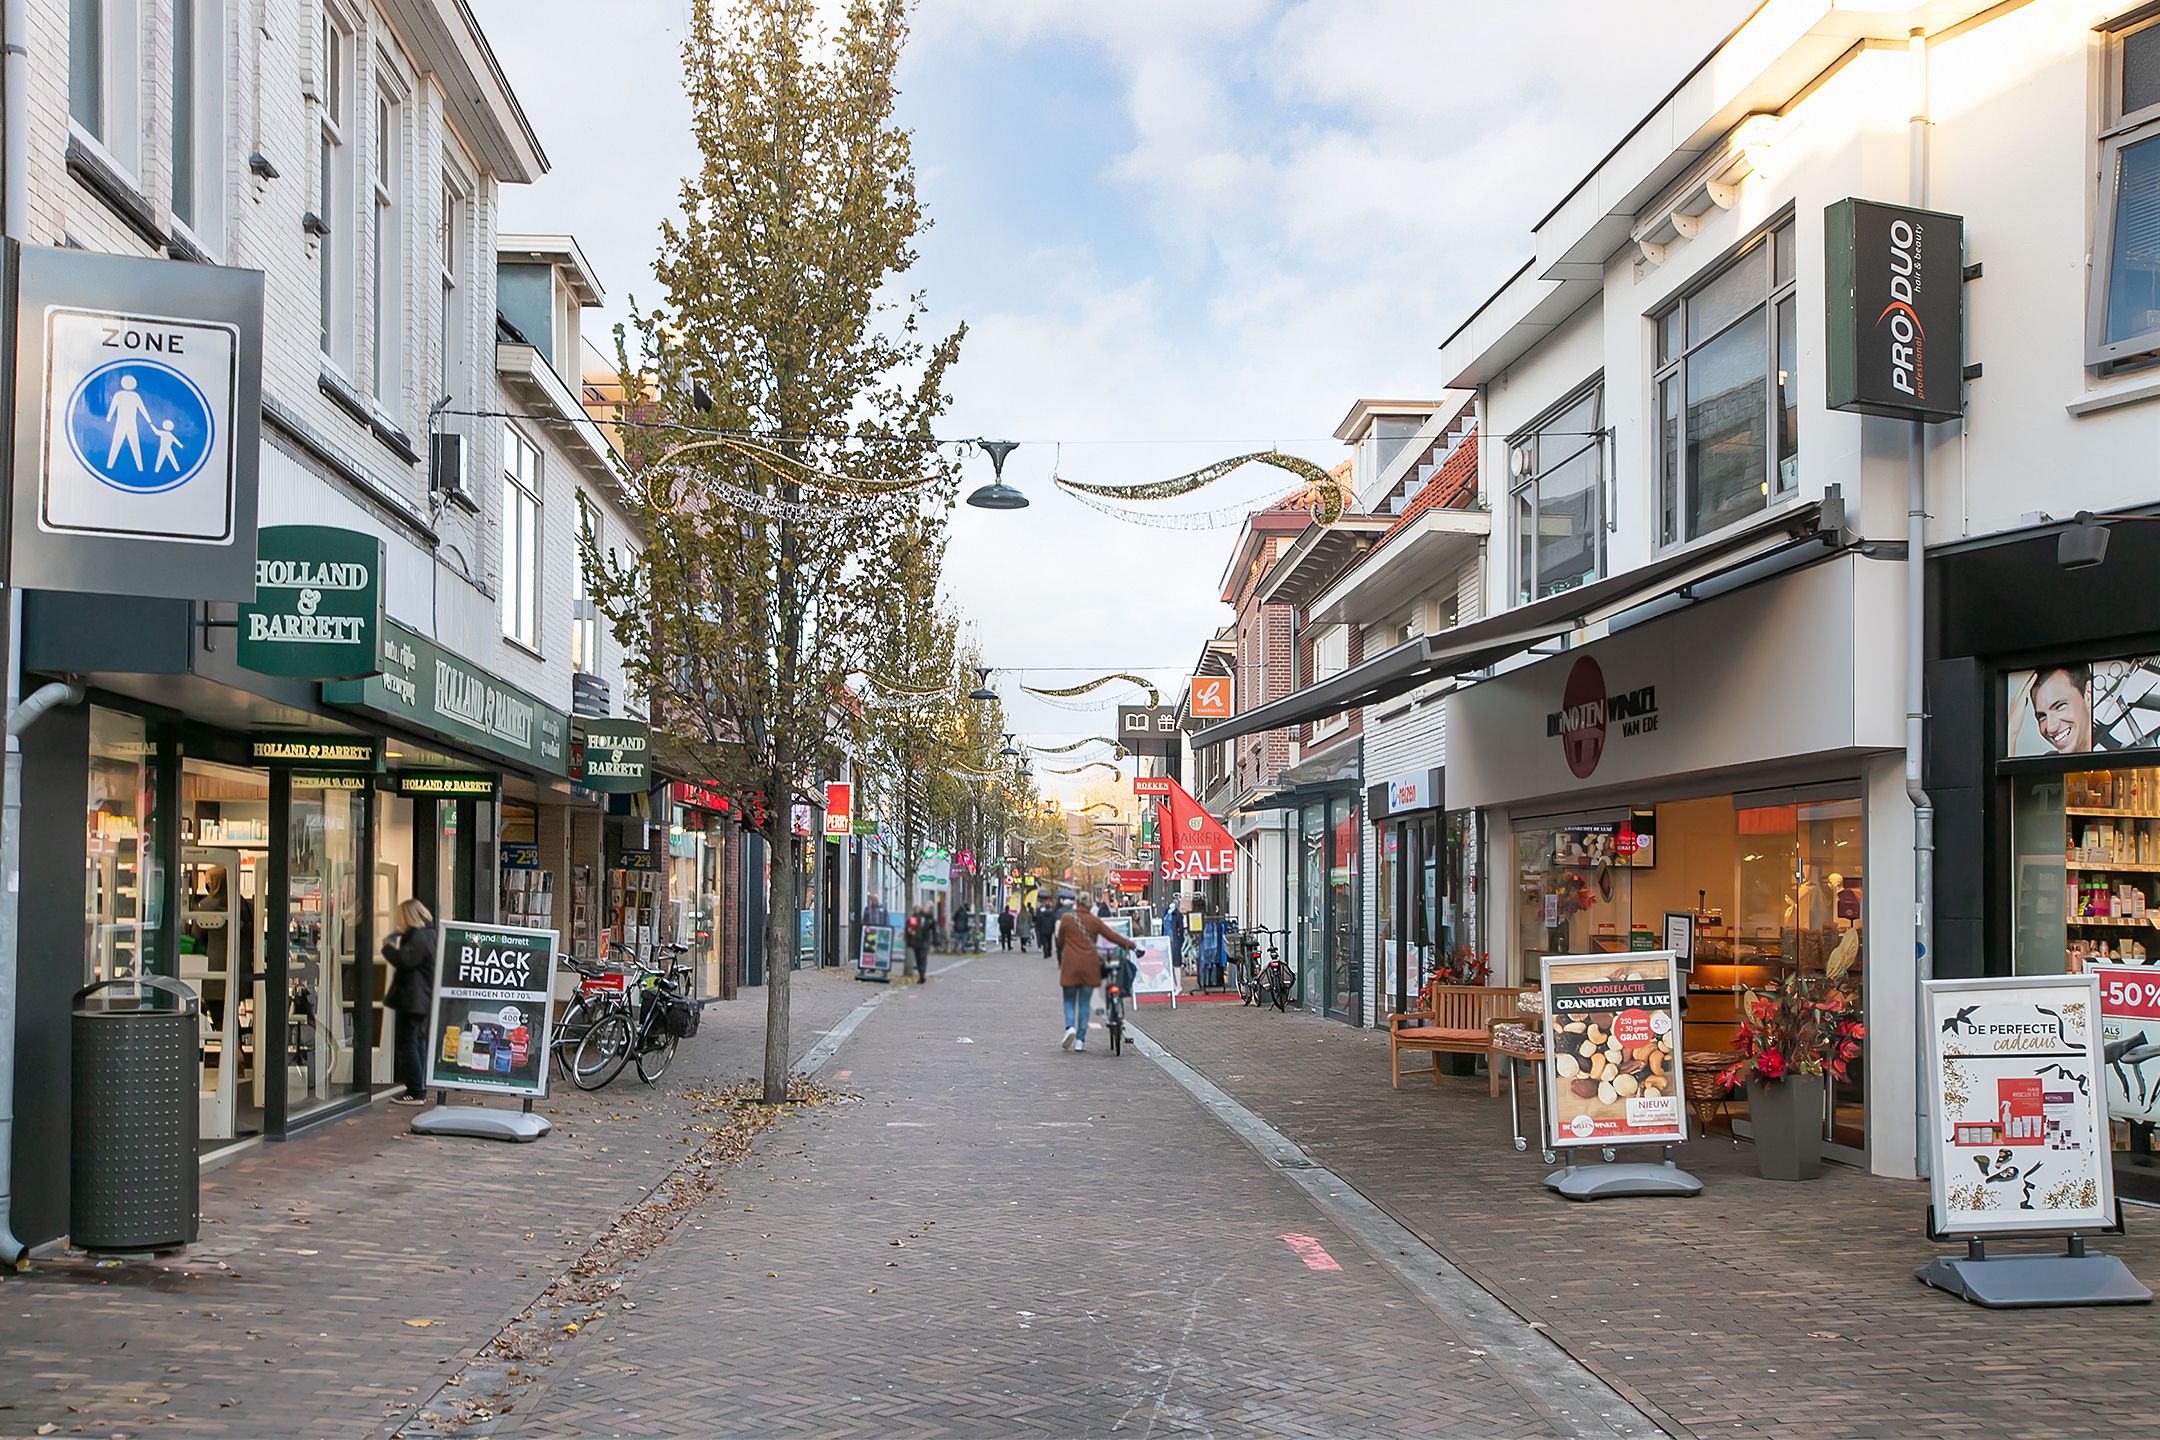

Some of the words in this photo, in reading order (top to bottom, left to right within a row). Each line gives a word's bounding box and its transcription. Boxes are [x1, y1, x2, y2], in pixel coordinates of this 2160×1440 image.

[1914, 223, 1924, 260] beauty
[102, 328, 184, 354] ZONE
[1916, 336, 1925, 400] professional
[256, 560, 369, 591] HOLLAND
[297, 588, 322, 616] &
[248, 613, 365, 644] BARRETT
[434, 658, 486, 733] HOLLAND
[485, 686, 496, 735] &
[492, 690, 534, 750] BARRETT
[1622, 720, 1640, 738] VAN
[1642, 715, 1658, 733] EDE
[588, 735, 646, 751] HOLLAND
[253, 743, 308, 758] HOLLAND
[308, 745, 320, 759] &
[319, 746, 372, 761] BARRETT
[611, 749, 623, 763] &
[588, 762, 644, 777] BARRETT
[402, 778, 444, 792] HOLLAND
[444, 781, 453, 792] &
[453, 781, 492, 793] BARRETT
[1136, 781, 1169, 791] BOEKEN
[828, 815, 848, 829] PERRY
[1173, 832, 1222, 844] BAKKER
[501, 851, 509, 863] 4
[1174, 850, 1233, 873] SALE
[501, 935, 530, 946] Barrett
[461, 946, 531, 971] BLACK
[458, 966, 530, 988] FRIDAY
[451, 989, 499, 999] KORTINGEN
[1578, 984, 1645, 994] VOORDEELACTIE
[1557, 997, 1623, 1010] CRANBERRY
[1626, 997, 1641, 1006] DE
[1643, 995, 1670, 1005] LUXE
[502, 1014, 518, 1022] 400
[1620, 1033, 1649, 1041] GRATIS
[1969, 1025, 1986, 1035] DE
[1990, 1024, 2057, 1035] PERFECTE
[1993, 1032, 2057, 1050] cadeaus
[1638, 1100, 1670, 1109] NIEUW
